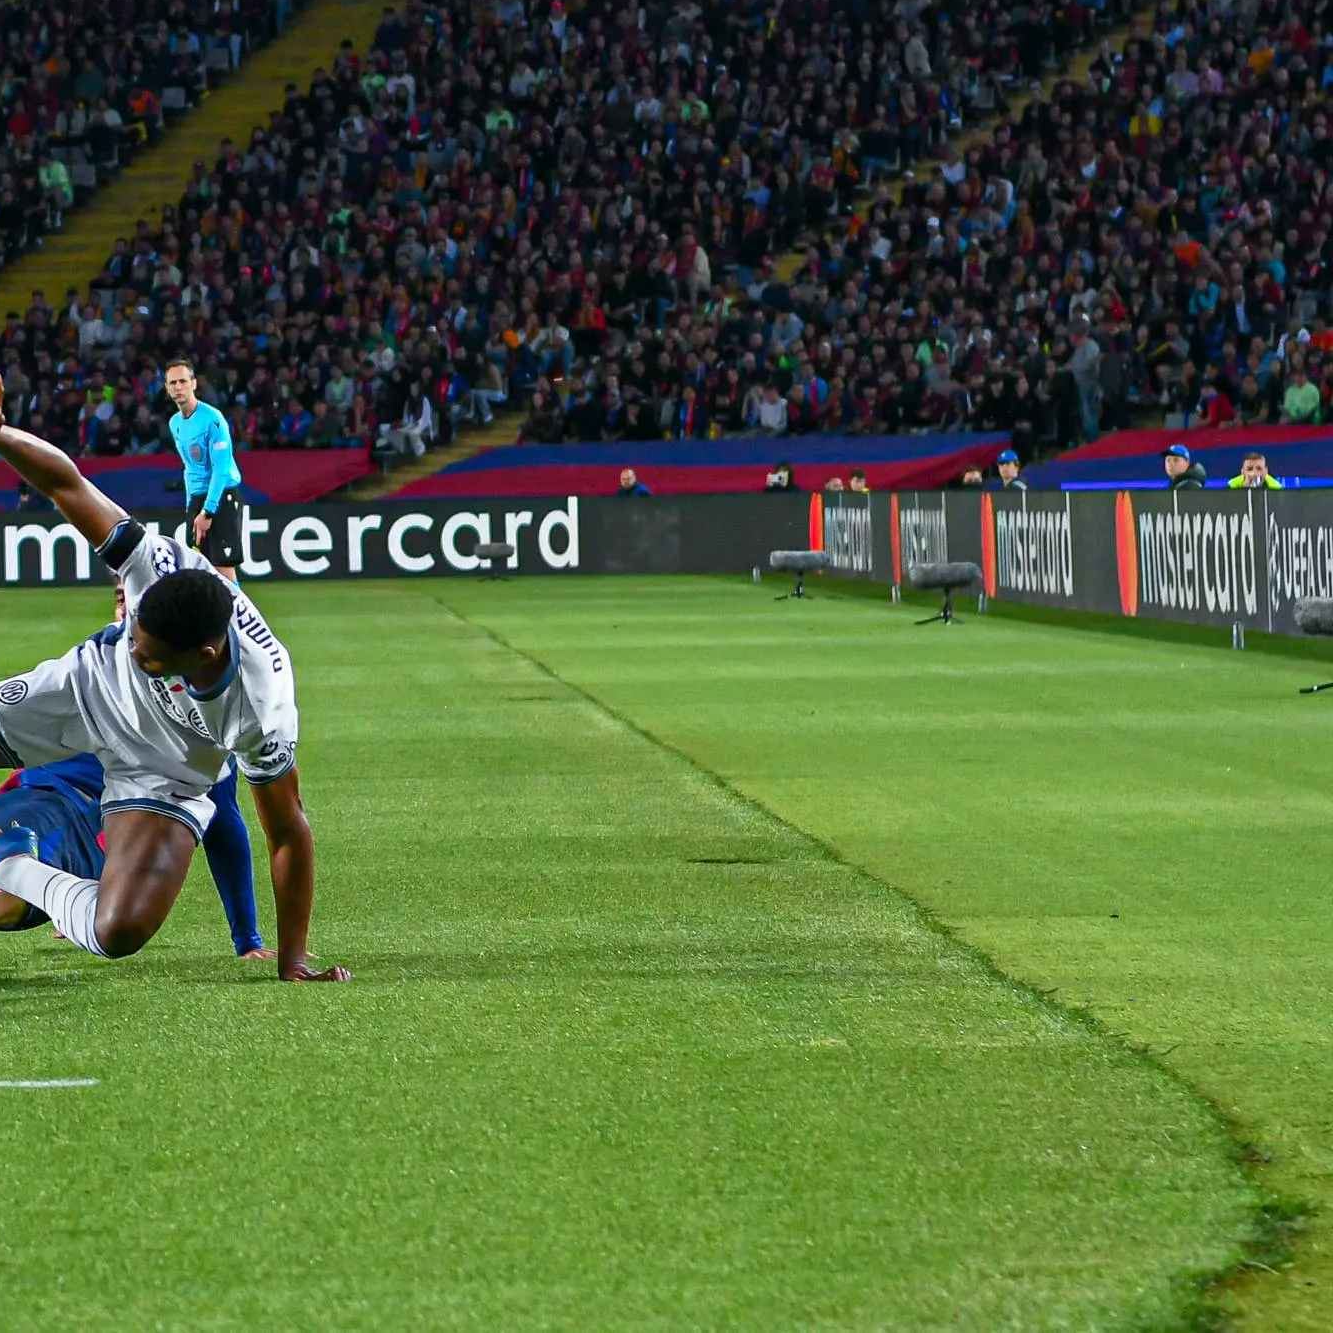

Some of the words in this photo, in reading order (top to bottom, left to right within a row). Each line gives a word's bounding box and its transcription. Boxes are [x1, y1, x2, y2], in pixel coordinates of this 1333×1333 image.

[4, 495, 580, 582] mtercard
[1139, 488, 1258, 616] mastercard
[1283, 527, 1315, 601] UEFA
